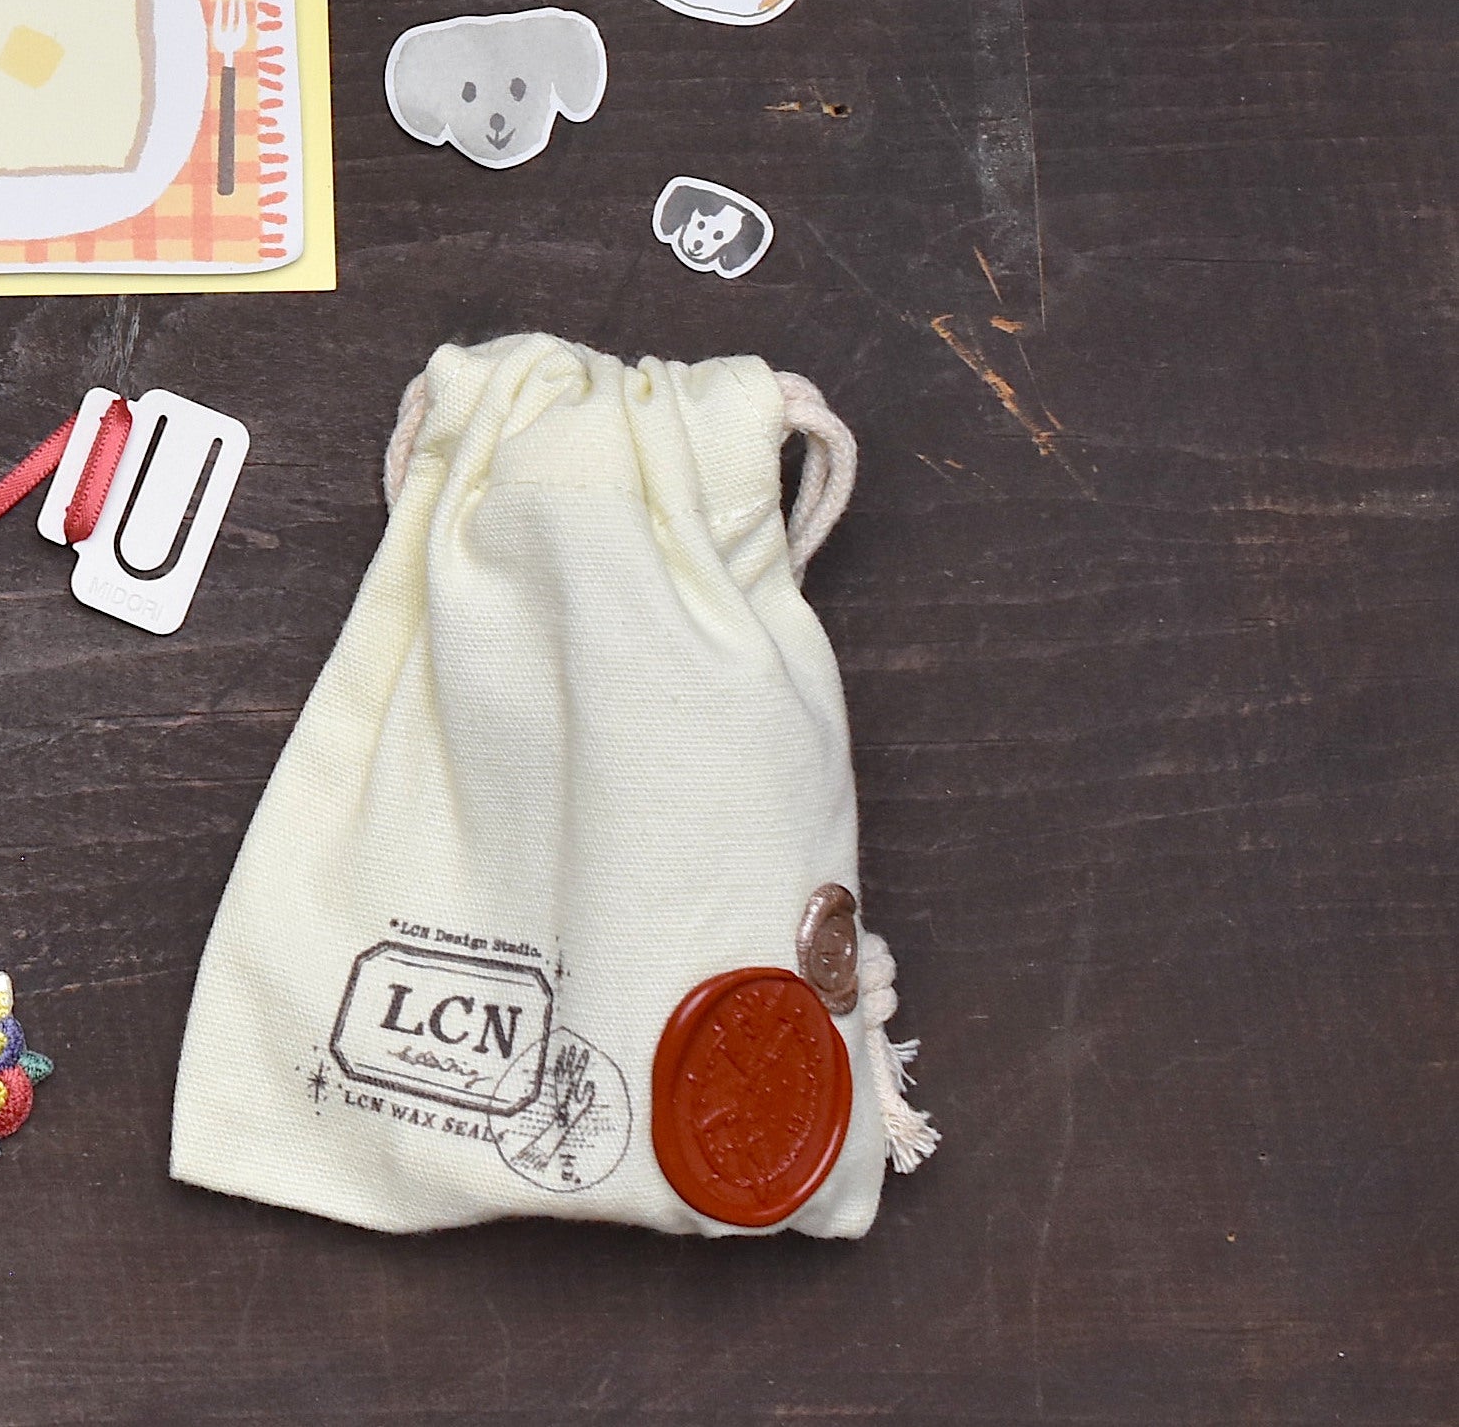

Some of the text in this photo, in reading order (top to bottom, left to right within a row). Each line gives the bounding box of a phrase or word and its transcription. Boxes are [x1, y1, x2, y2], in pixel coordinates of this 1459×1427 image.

[89, 576, 163, 622] MIDORI
[436, 929, 488, 951] Design
[380, 983, 523, 1059] LCN
[391, 1100, 436, 1129] WAX
